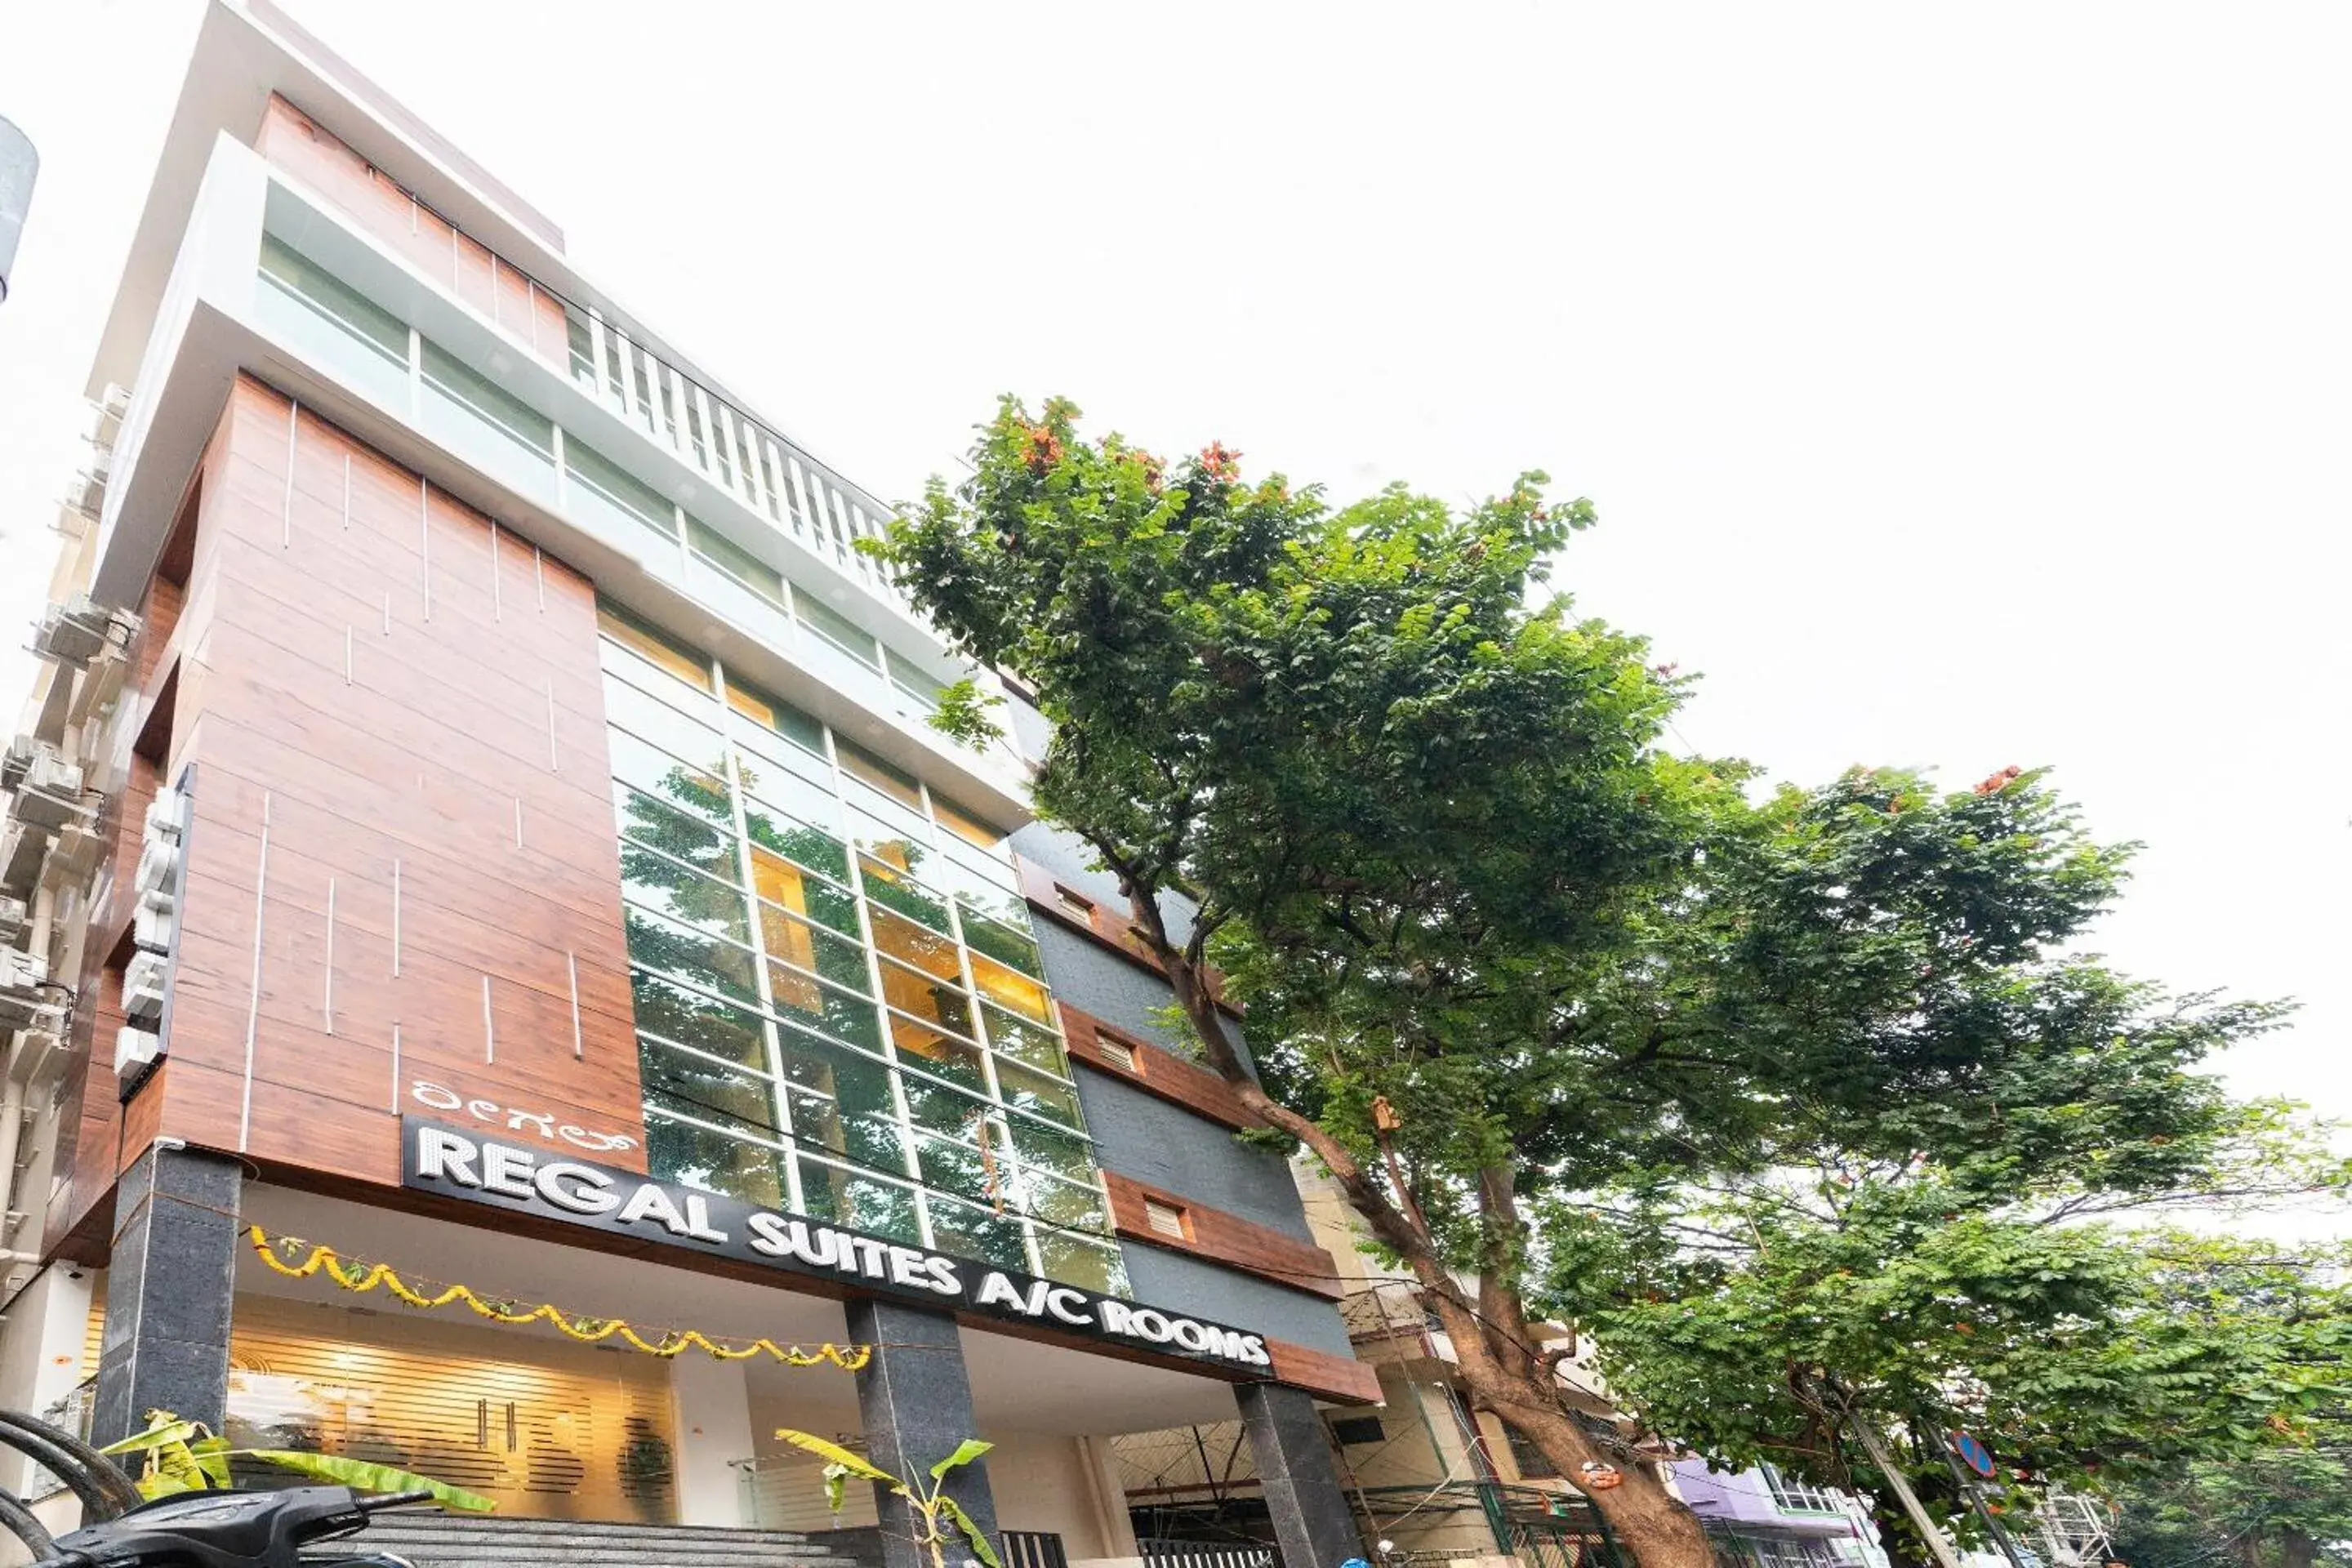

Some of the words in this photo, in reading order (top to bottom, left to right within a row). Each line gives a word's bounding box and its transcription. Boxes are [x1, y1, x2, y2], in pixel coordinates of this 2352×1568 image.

[416, 1125, 729, 1244] REGAL
[746, 1212, 963, 1296] SUITES
[978, 1271, 1094, 1325] A/C
[1098, 1299, 1271, 1366] ROOMS
